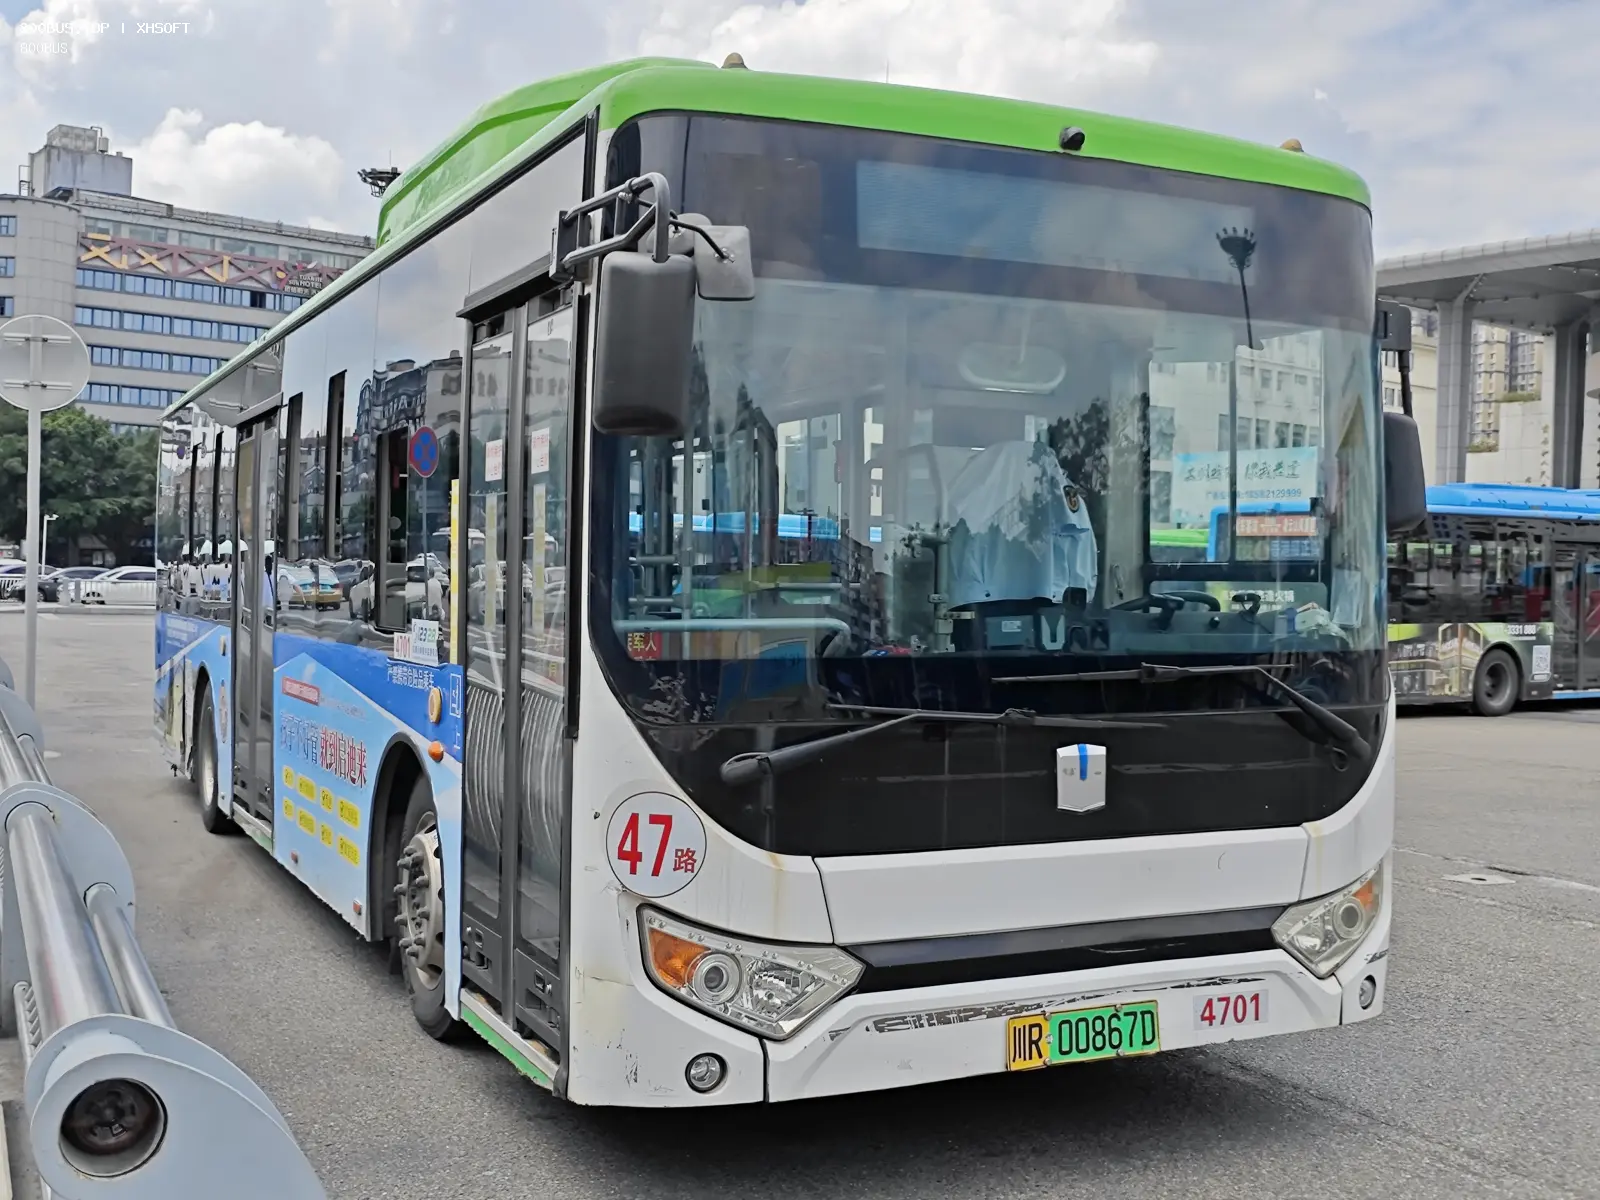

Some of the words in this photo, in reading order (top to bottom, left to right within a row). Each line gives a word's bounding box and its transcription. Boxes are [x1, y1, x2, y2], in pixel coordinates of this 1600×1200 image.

[300, 280, 322, 289] HOTEL
[1199, 992, 1261, 1027] 4701
[1012, 1022, 1043, 1063] 川R
[1057, 1009, 1156, 1056] 00867D
